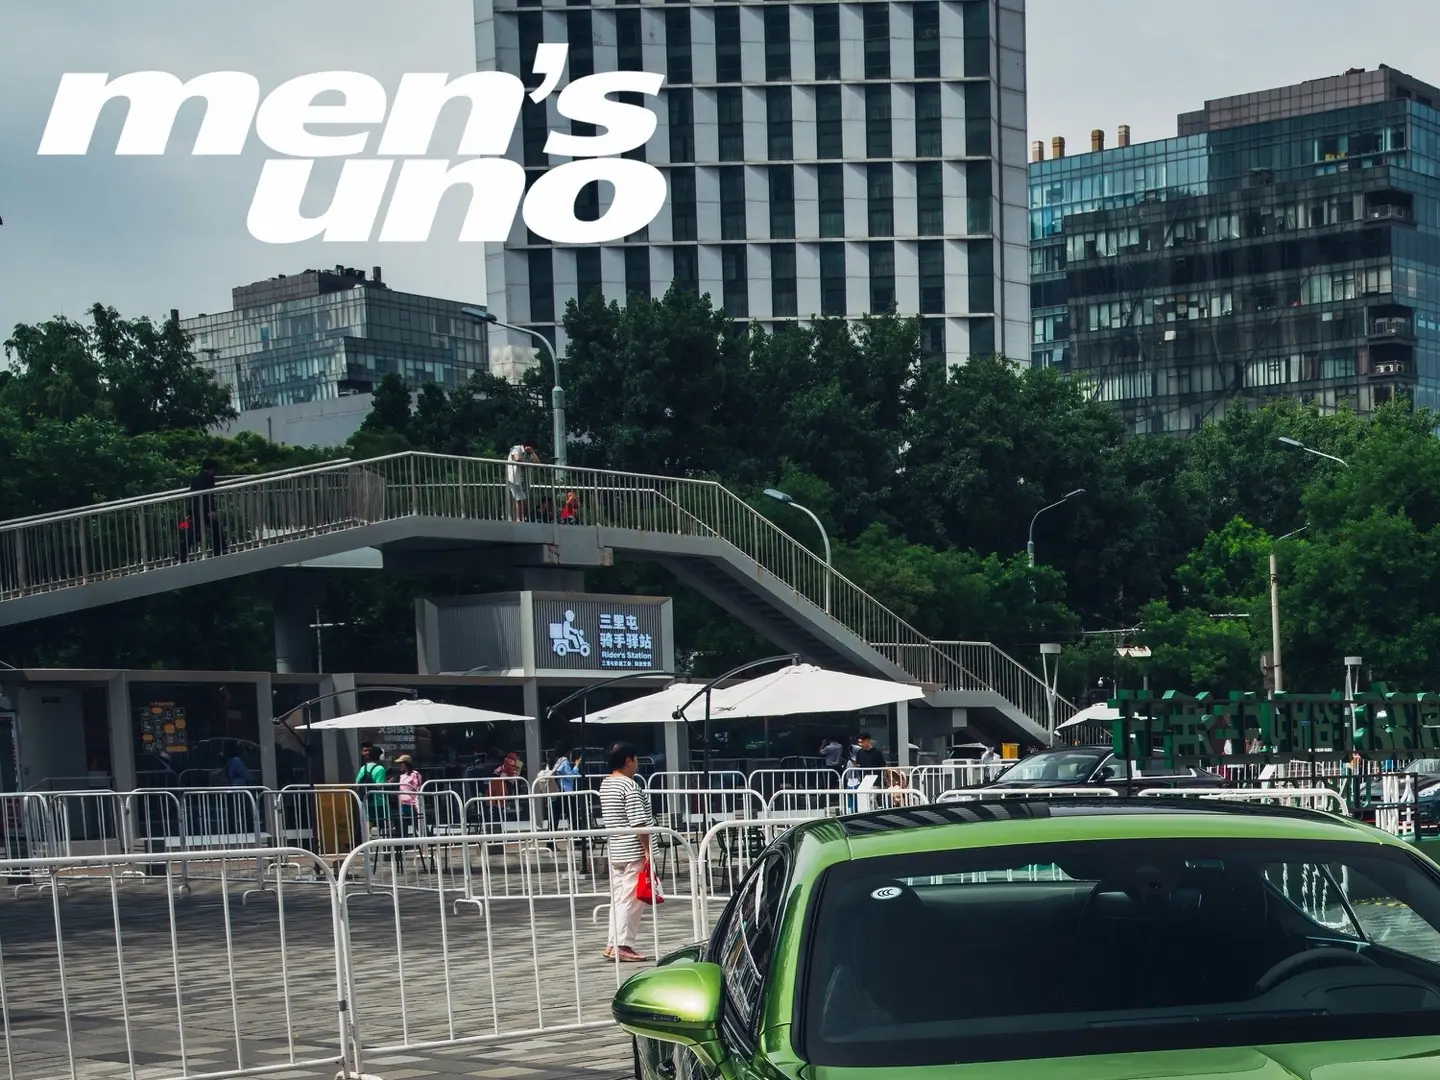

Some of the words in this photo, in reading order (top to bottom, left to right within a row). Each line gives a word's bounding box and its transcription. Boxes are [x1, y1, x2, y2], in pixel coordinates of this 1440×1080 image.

[599, 614, 638, 630] 三里屯
[599, 632, 651, 649] 骑手驿站
[601, 651, 625, 659] Rider's
[627, 651, 652, 660] Station
